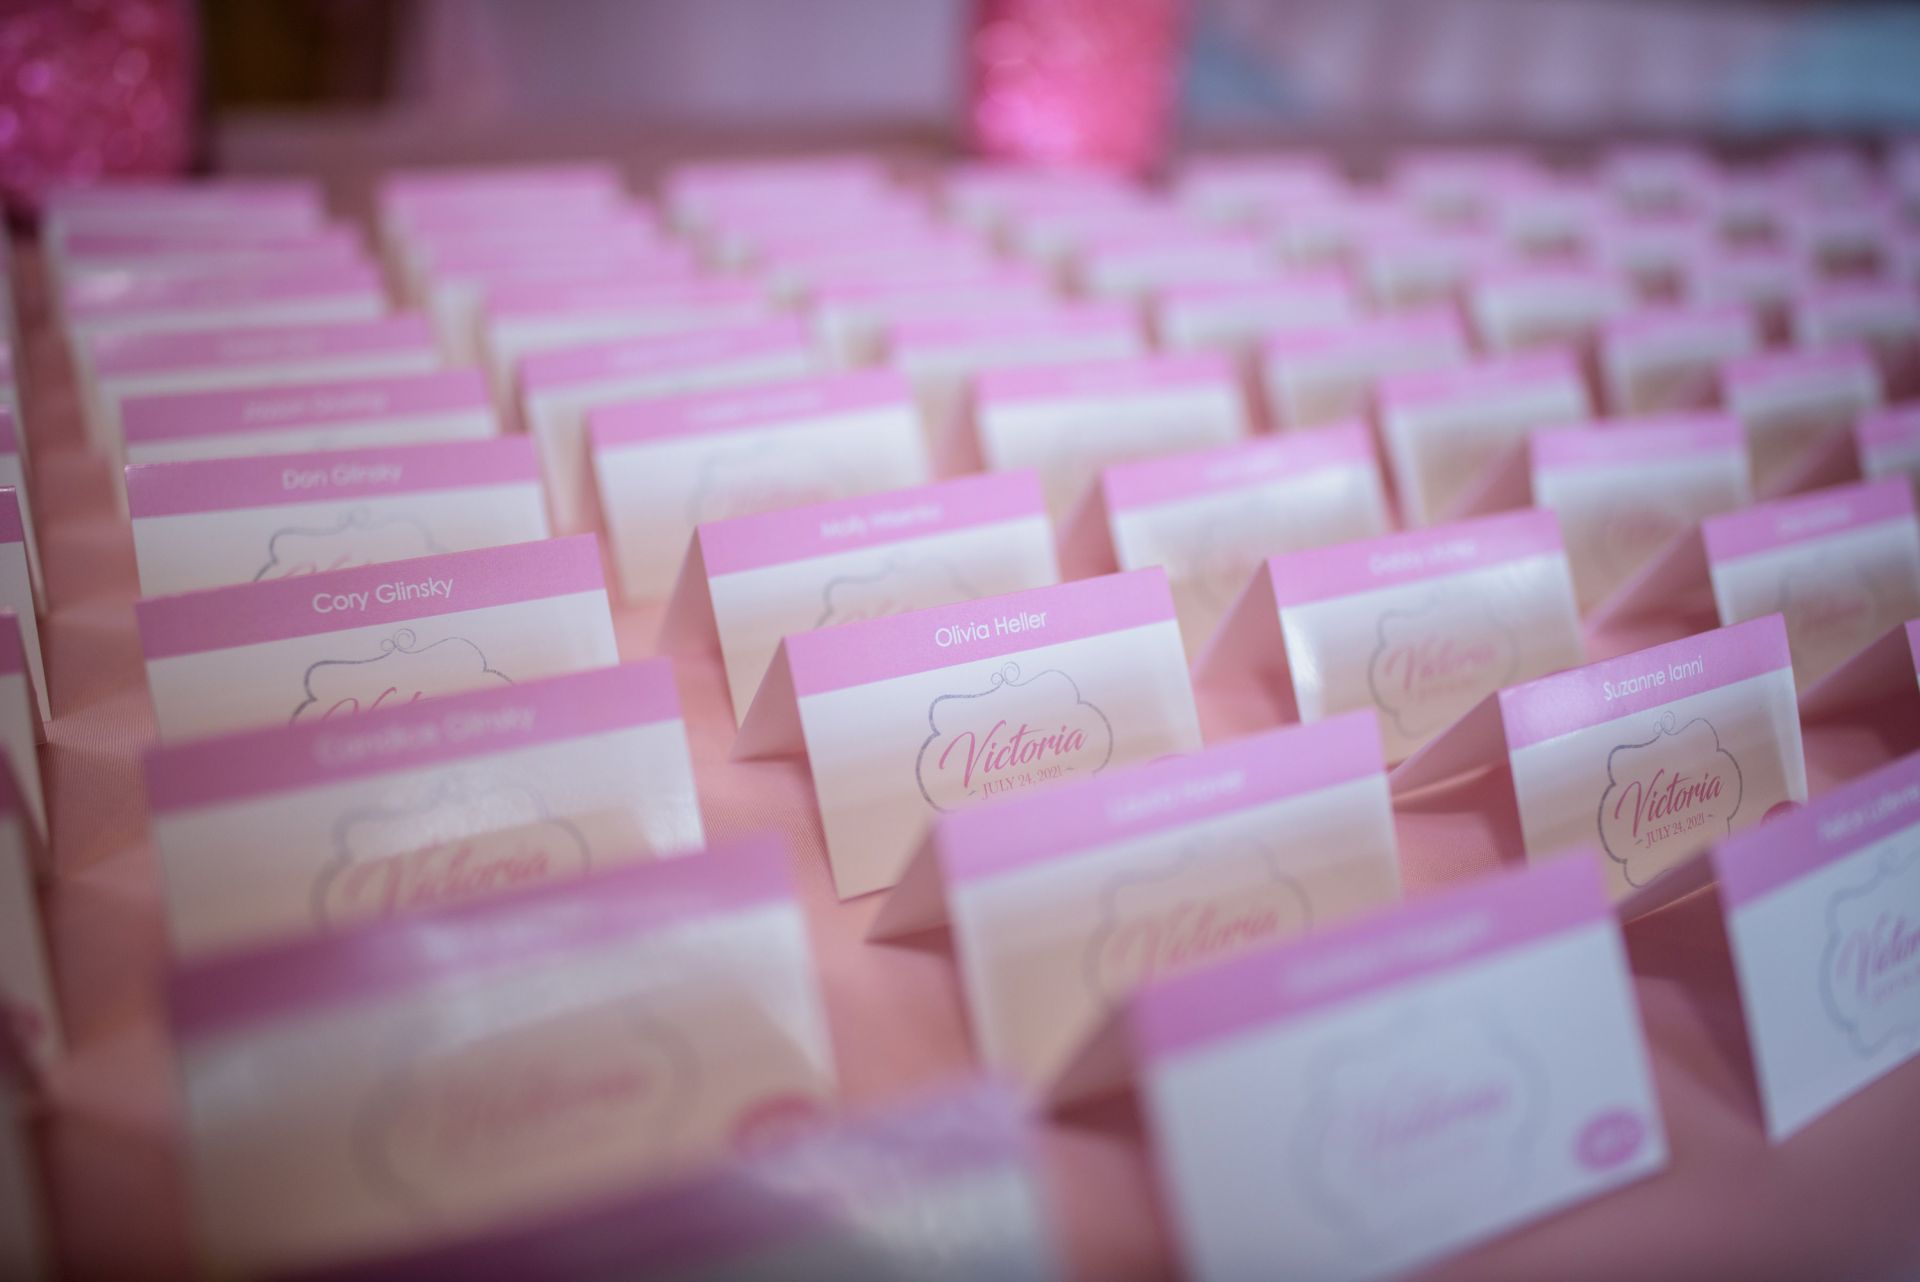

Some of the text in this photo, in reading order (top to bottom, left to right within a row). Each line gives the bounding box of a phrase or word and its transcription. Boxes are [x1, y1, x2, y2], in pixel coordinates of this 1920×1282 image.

[312, 577, 454, 613] Cory Glinsky
[935, 610, 1048, 647] Olivia Heller
[1602, 655, 1705, 701] Suzanne Ianni
[938, 719, 1089, 788] Victoria
[982, 776, 1015, 800] JULY
[1039, 765, 1063, 782] 2021
[1614, 768, 1723, 838] Victoria
[1645, 812, 1705, 848] JULY 24, 2021
